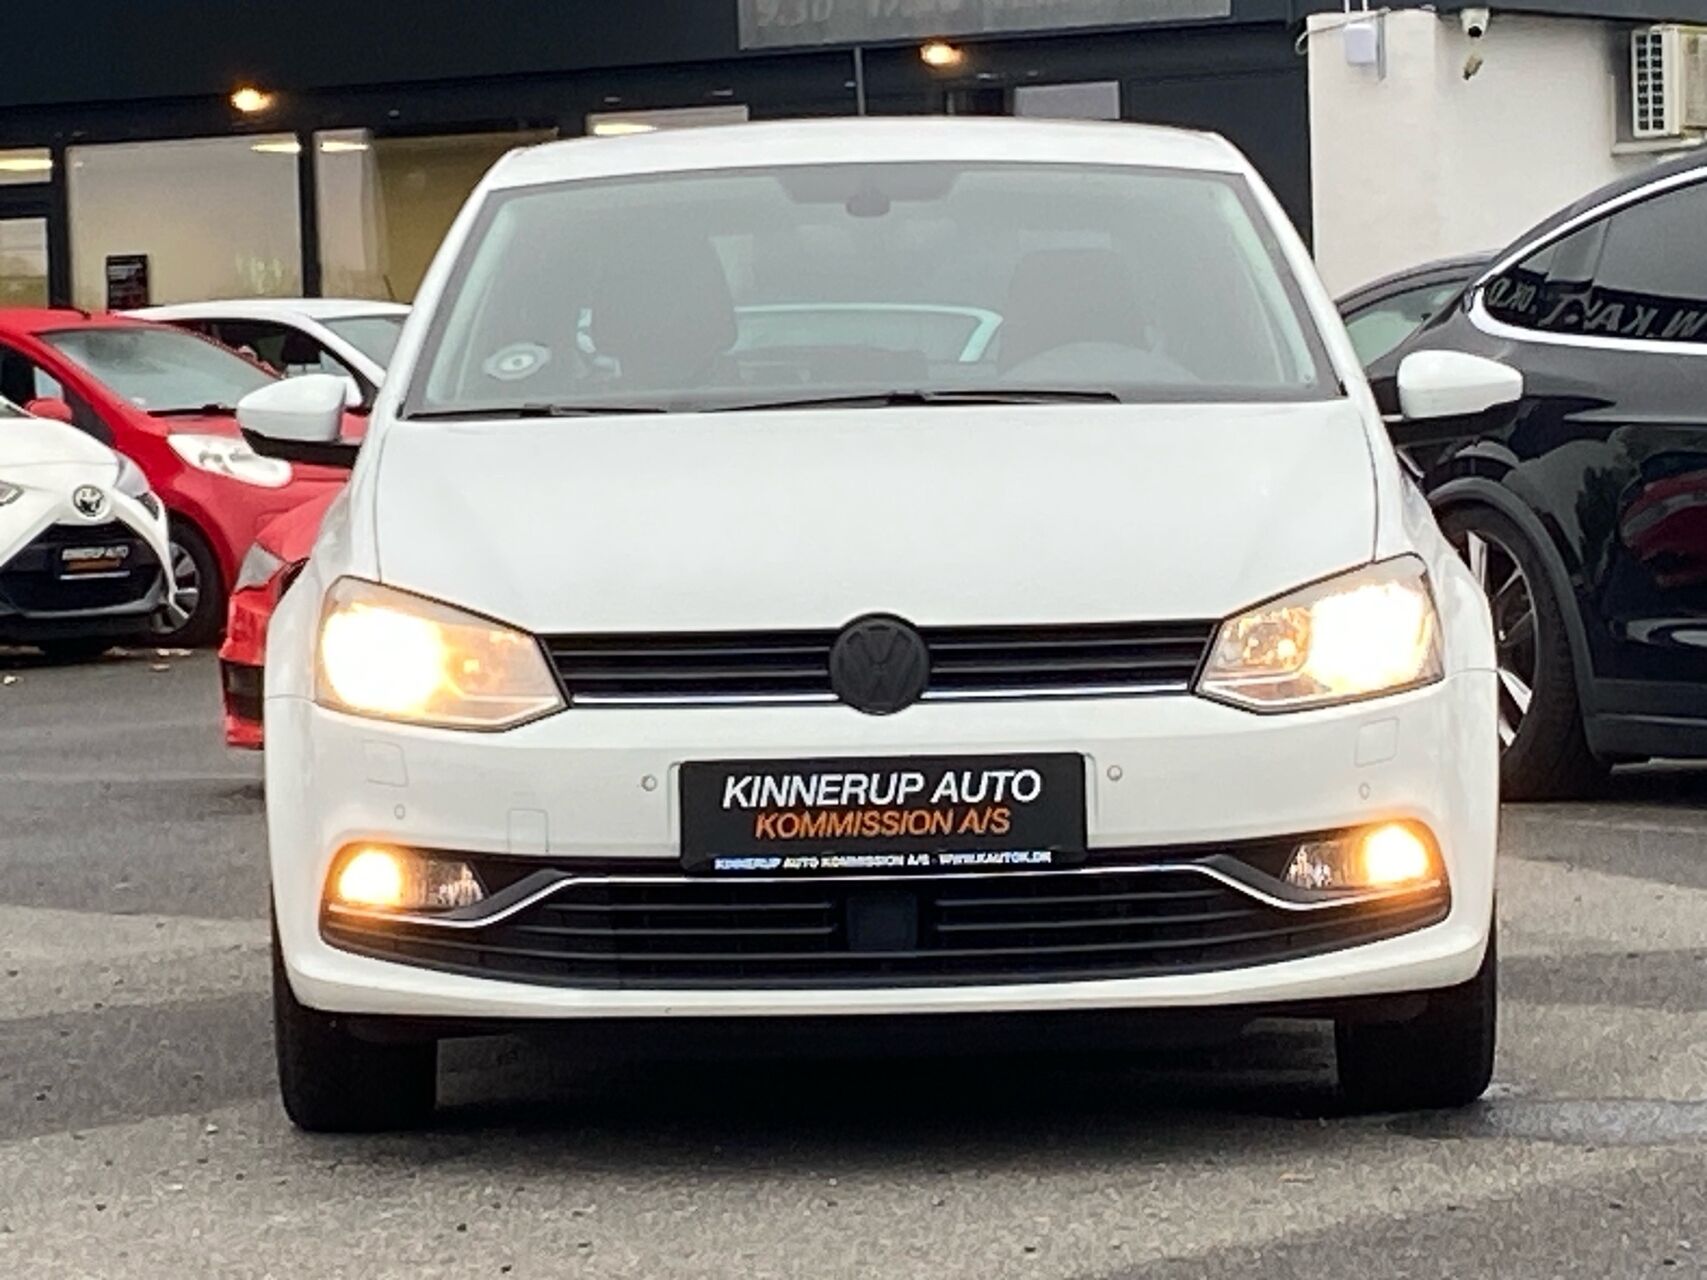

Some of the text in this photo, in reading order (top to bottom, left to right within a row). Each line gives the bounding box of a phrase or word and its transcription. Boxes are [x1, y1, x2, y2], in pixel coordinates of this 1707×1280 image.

[722, 768, 1042, 809] KINNERUP AUTO
[754, 806, 1011, 840] KOMMISSION A/S
[783, 856, 820, 869] AUTO
